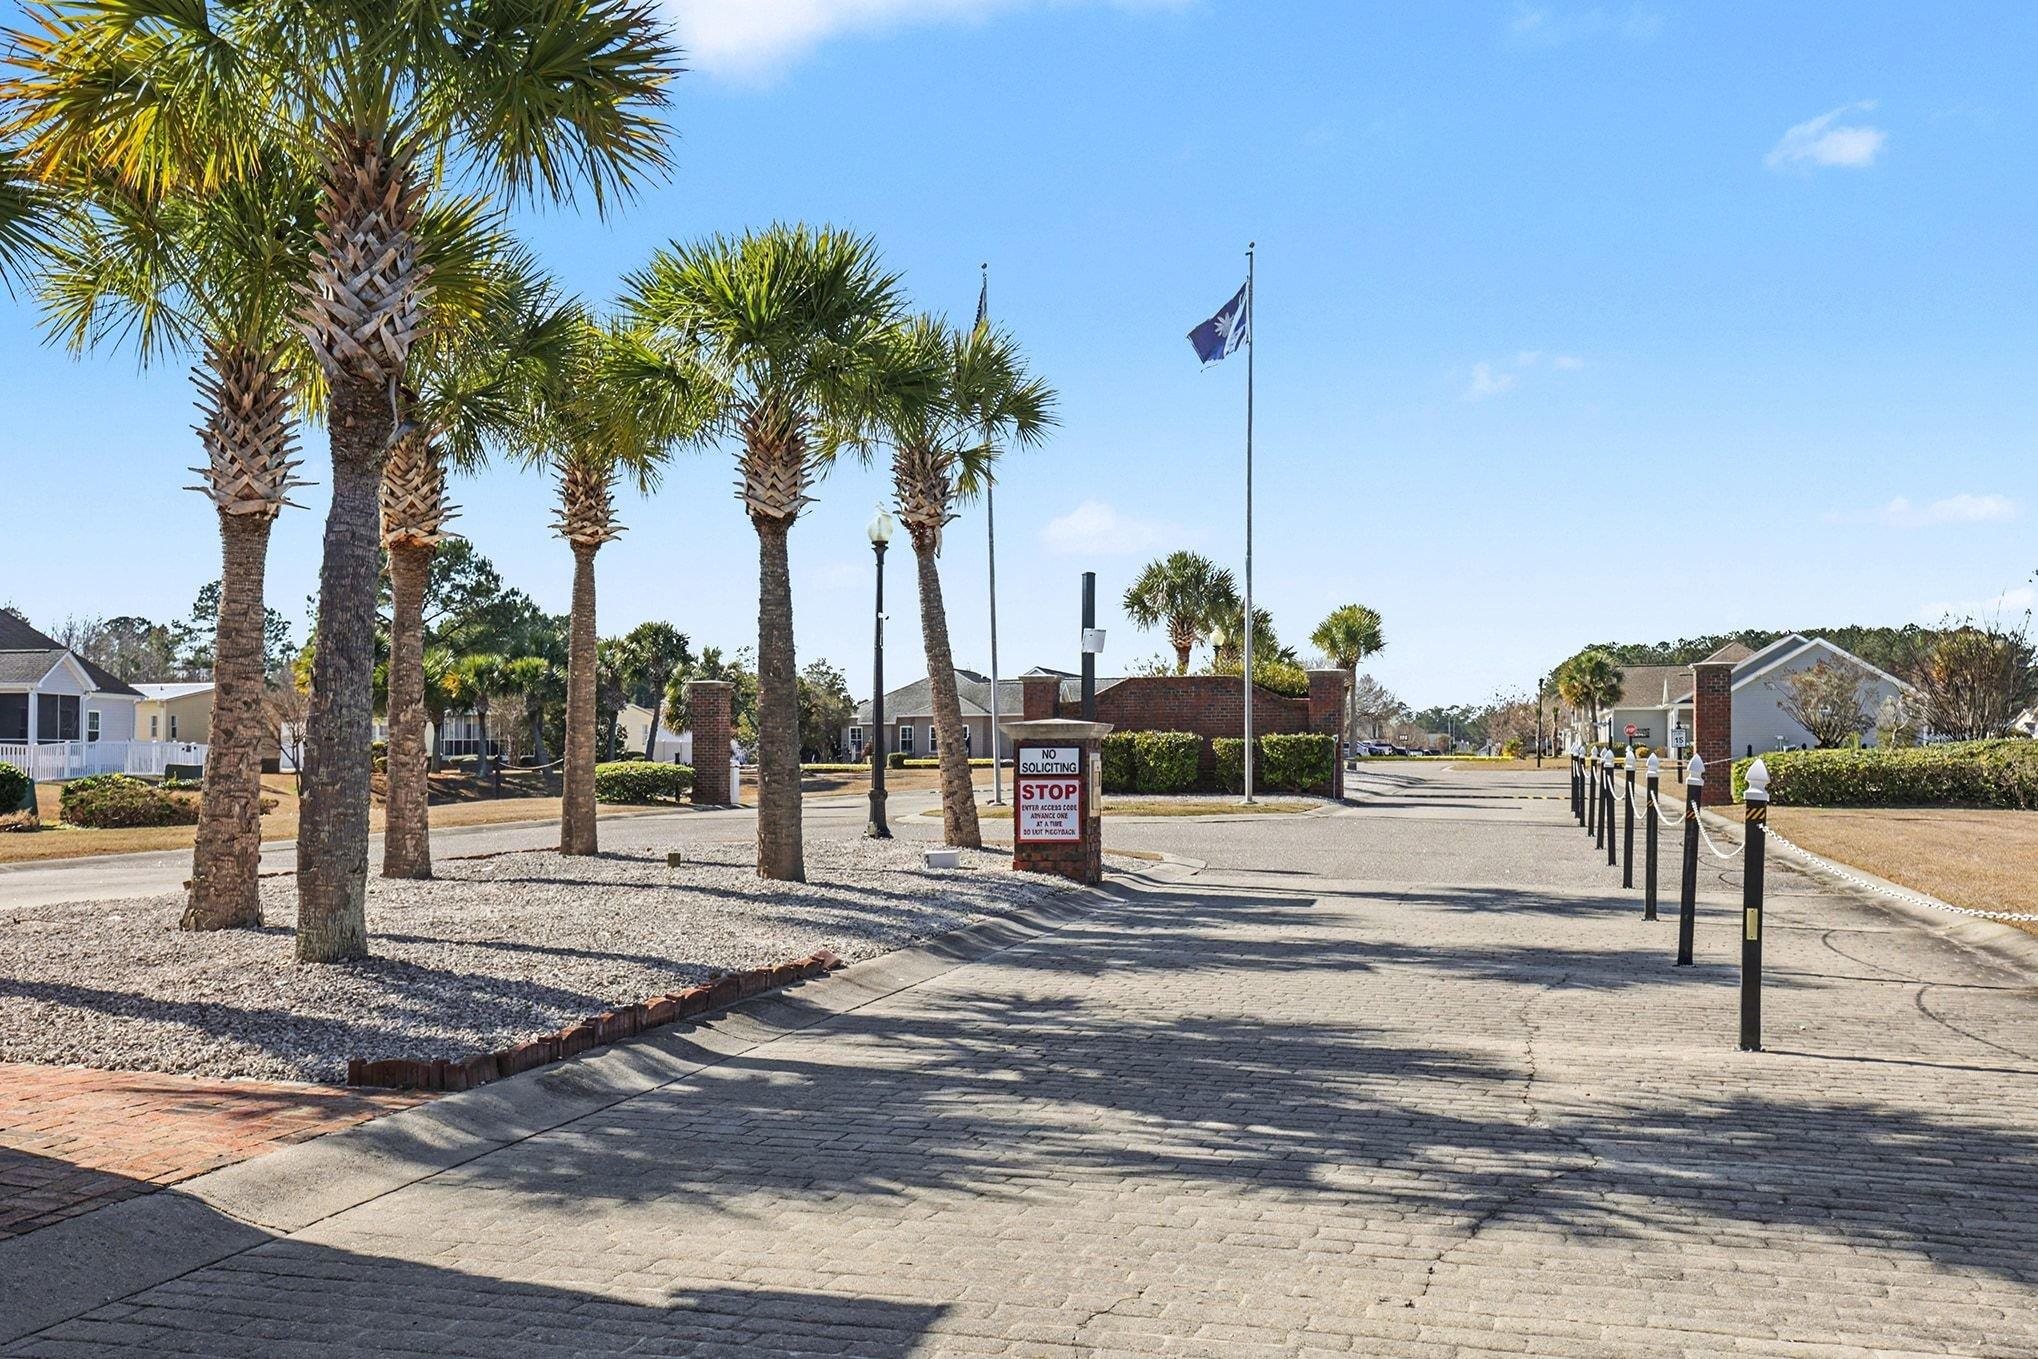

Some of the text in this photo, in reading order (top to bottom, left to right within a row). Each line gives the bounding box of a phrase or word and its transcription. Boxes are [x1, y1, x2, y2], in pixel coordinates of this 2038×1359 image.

[1042, 750, 1056, 759] NO
[1022, 762, 1076, 773] SOLICITING
[1022, 784, 1077, 800] STOP
